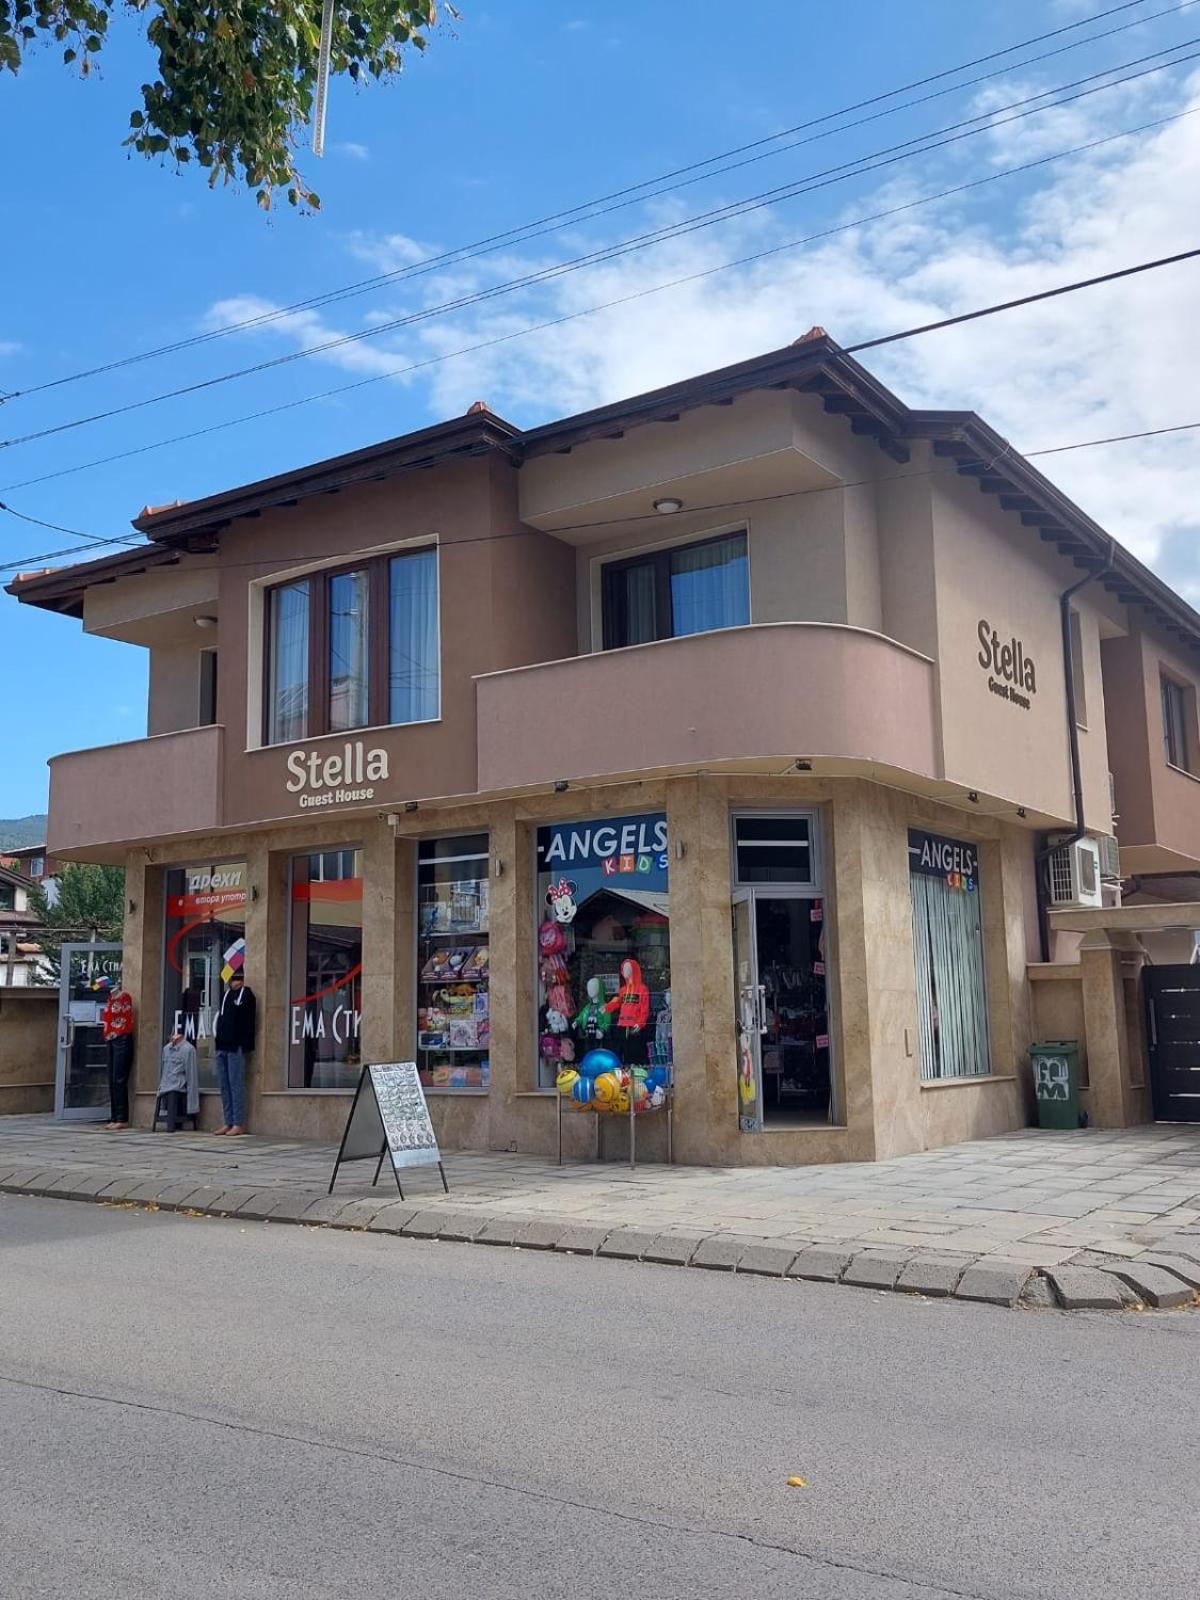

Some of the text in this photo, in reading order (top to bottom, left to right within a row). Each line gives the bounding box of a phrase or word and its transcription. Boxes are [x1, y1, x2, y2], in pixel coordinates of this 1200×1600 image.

[978, 619, 1037, 694] Stella
[286, 741, 390, 793] Stella
[299, 788, 374, 808] Guest House
[604, 855, 668, 875] KIDS
